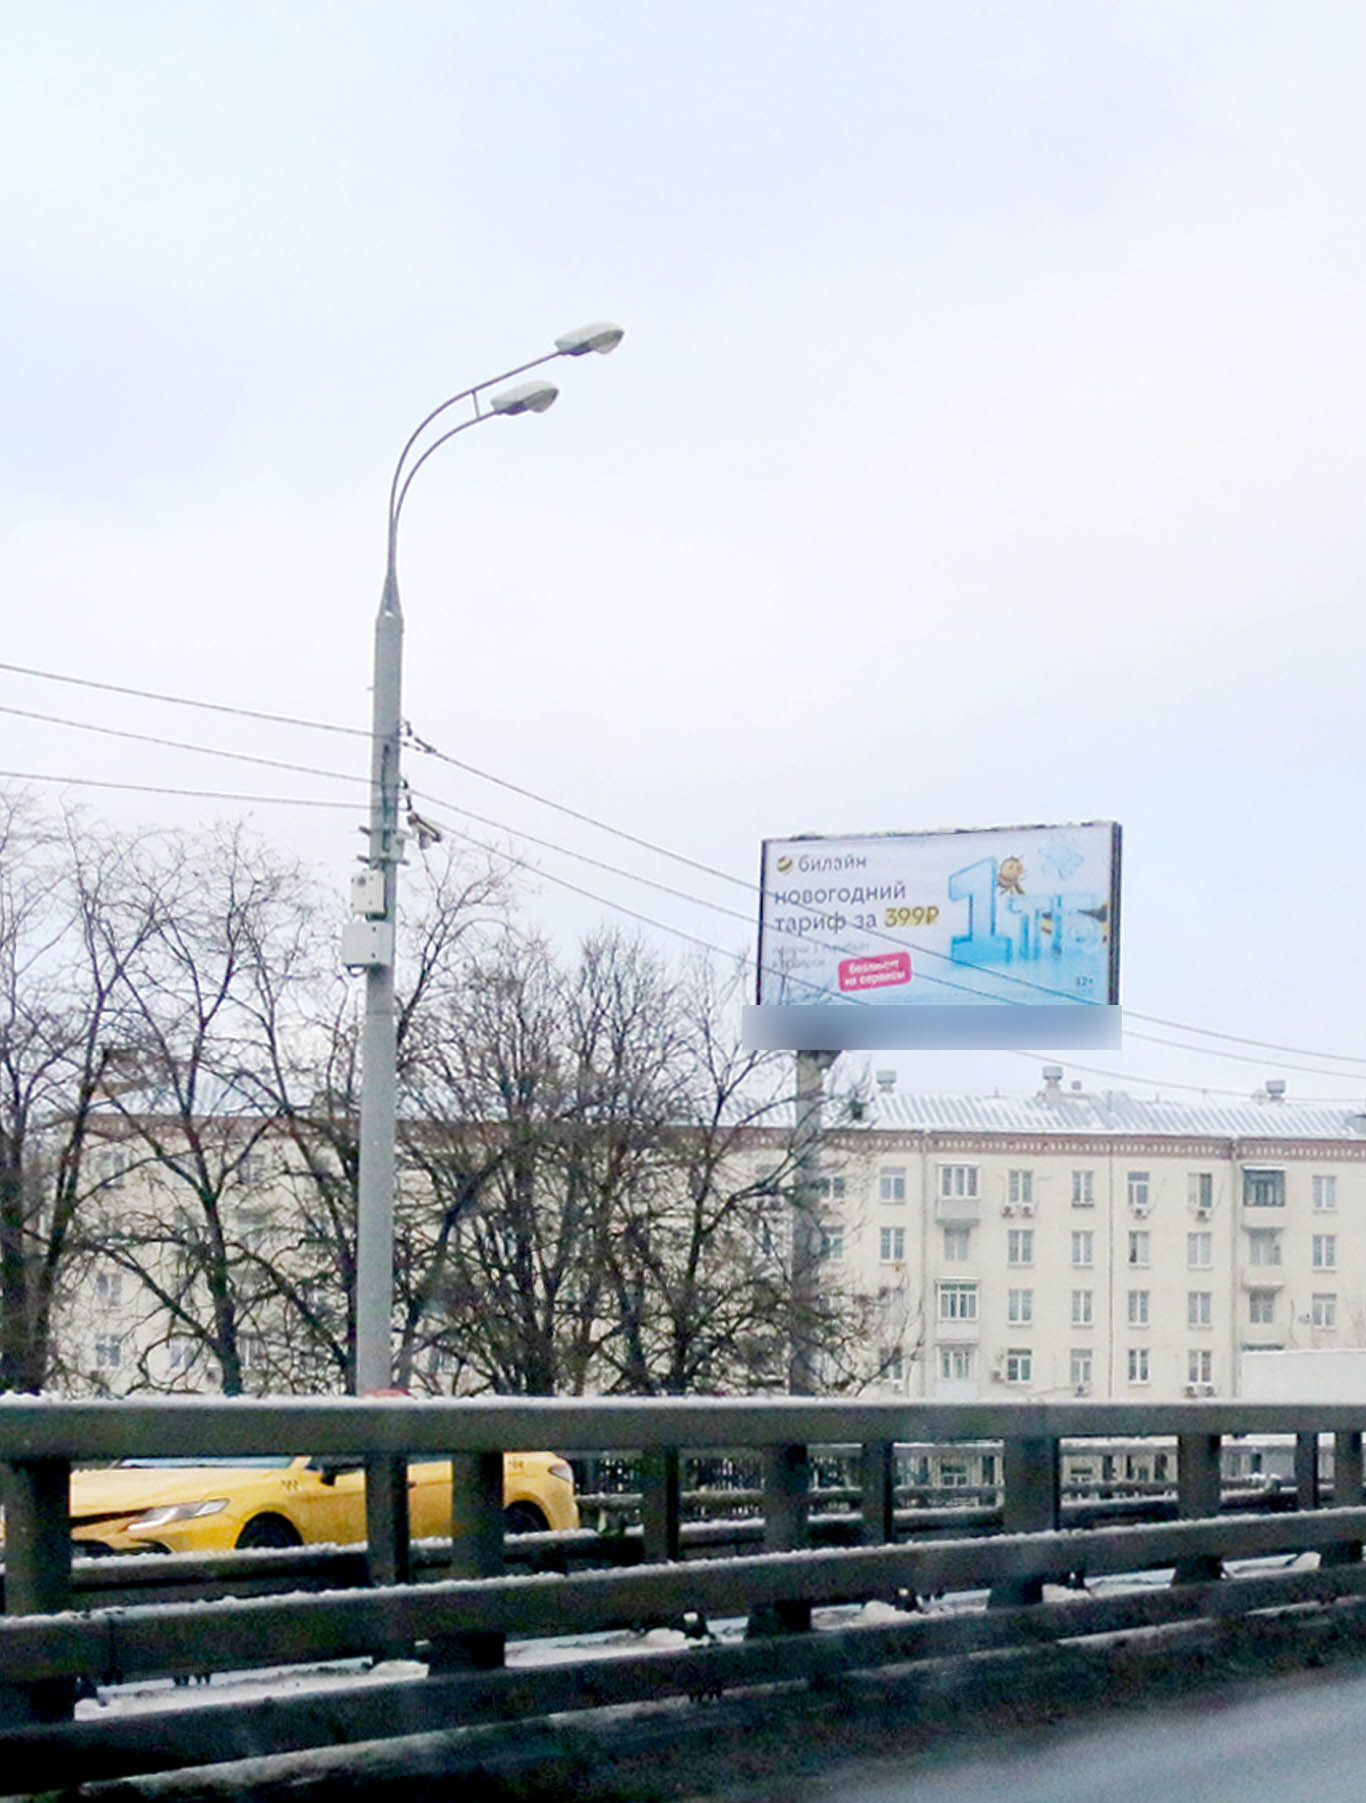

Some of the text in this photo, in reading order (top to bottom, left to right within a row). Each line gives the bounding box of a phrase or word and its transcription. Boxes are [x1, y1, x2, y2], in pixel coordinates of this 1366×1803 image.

[798, 855, 867, 873] билайн
[775, 881, 907, 905] новогодний
[775, 911, 847, 935] тариф
[855, 913, 877, 929] за
